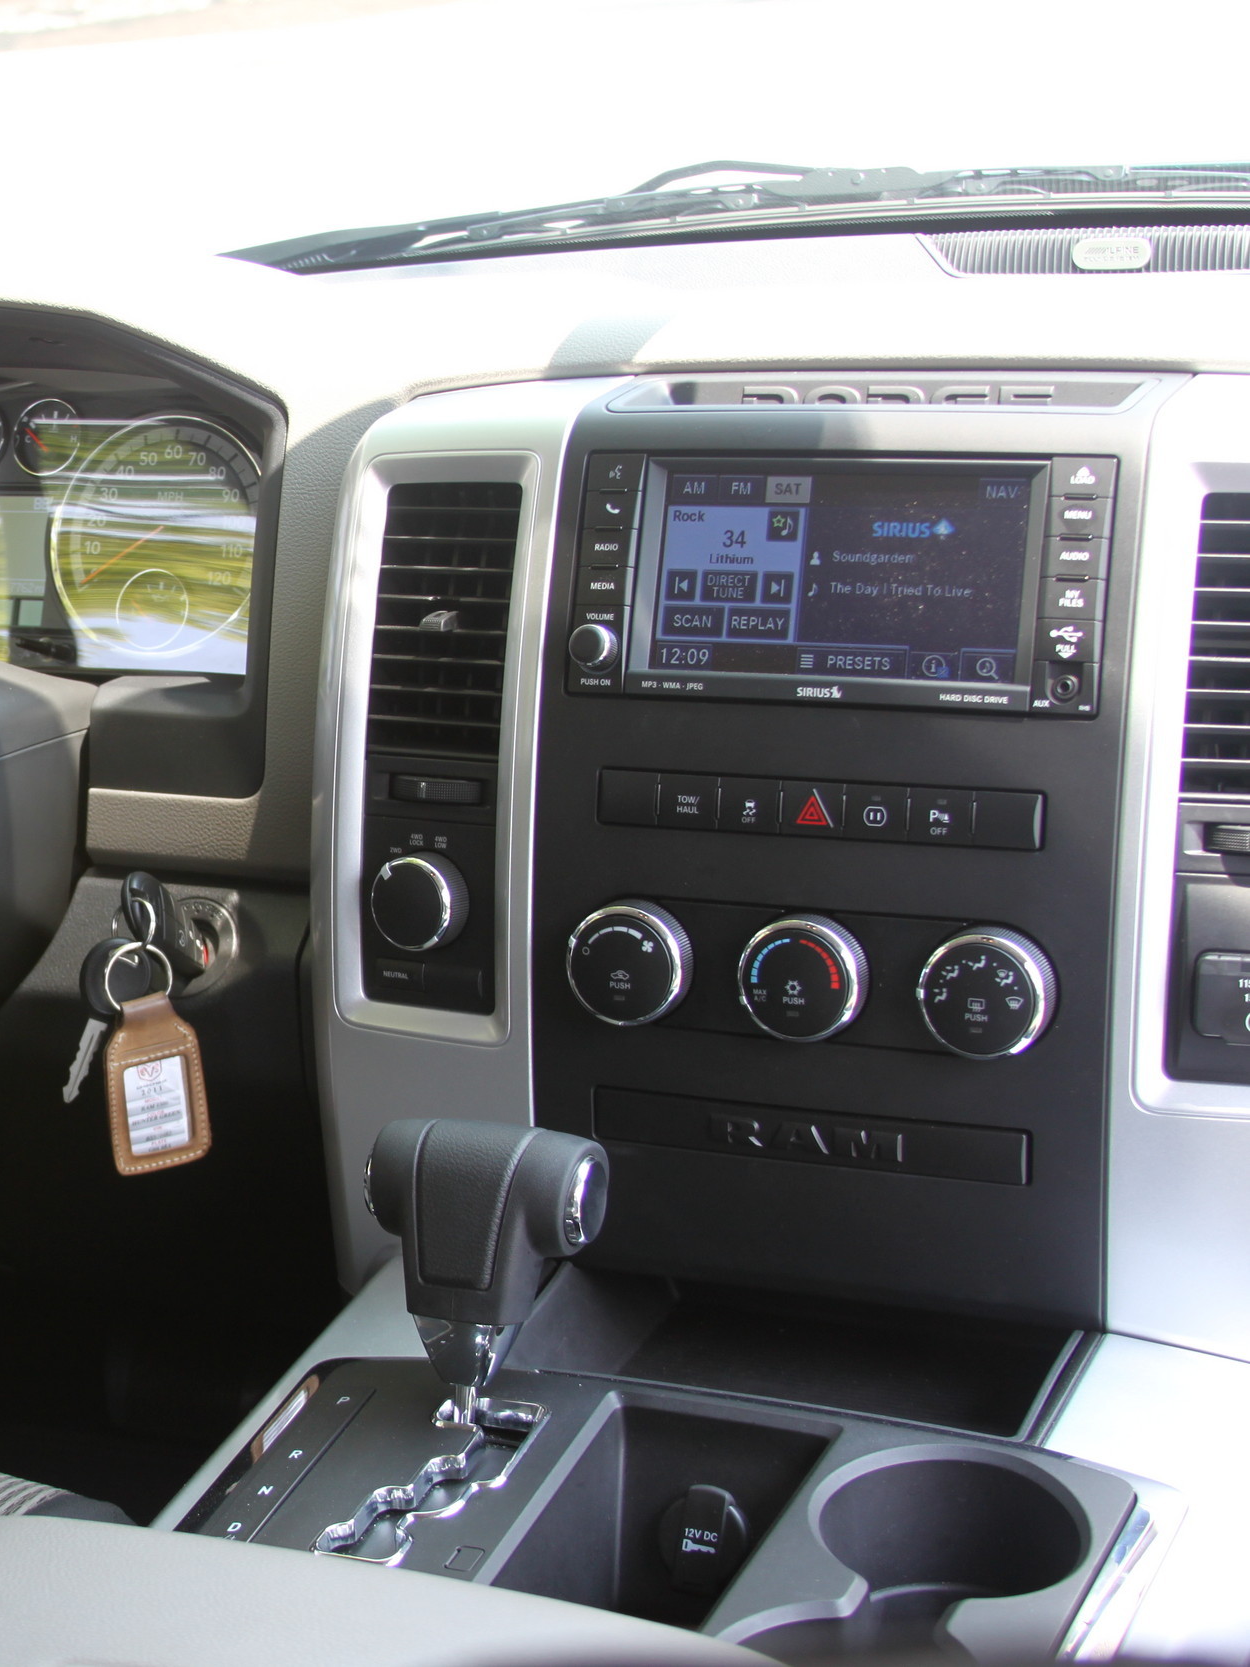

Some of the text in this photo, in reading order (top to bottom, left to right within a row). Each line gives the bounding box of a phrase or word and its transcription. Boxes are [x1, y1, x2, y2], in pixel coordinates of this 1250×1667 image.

[165, 445, 182, 459] 60
[139, 452, 157, 466] 50
[188, 452, 206, 466] 70
[116, 466, 135, 479] 40
[208, 466, 226, 480] 80
[1070, 475, 1096, 484] LOAD
[683, 482, 705, 494] AM
[731, 482, 751, 495] FM
[774, 483, 802, 495] SAT
[986, 485, 1019, 499] NAV
[100, 488, 118, 501] 30
[222, 488, 240, 502] 90
[673, 510, 706, 522] Rock
[1064, 510, 1092, 520] MENU
[872, 521, 932, 538] SIRIUS
[722, 530, 747, 549] 34
[84, 541, 101, 555] 10
[220, 545, 243, 558] 110
[594, 543, 619, 551] RADIO
[709, 553, 754, 565] Lithium
[832, 551, 916, 566] Soundgarden
[1059, 551, 1090, 561] AUDIO
[207, 572, 232, 585] 120
[707, 574, 751, 587] DIRECT
[590, 582, 615, 590] MEDIA
[830, 582, 852, 594] The
[856, 582, 879, 597] Day
[890, 584, 922, 596] Tried
[926, 584, 940, 597] To
[945, 585, 973, 598] Live
[712, 587, 745, 599] TUNE
[1065, 589, 1081, 598] MY
[1059, 598, 1084, 608] FILES
[586, 612, 614, 621] VOLUME
[673, 614, 712, 628] SCAN
[731, 616, 785, 630] REPLAY
[1055, 644, 1077, 653] PULL
[660, 648, 709, 665] 12:09
[827, 655, 891, 671] PRESETS
[580, 678, 611, 686] PUSH ON
[641, 680, 704, 691] MP3 WMA JPEG
[796, 686, 831, 698] SIRIUS
[939, 693, 1009, 705] HARD DISC DRIVE
[1033, 700, 1050, 708] AUX
[677, 795, 700, 805] TOW/
[676, 805, 699, 814] HAUL
[741, 816, 756, 824] OFF
[930, 827, 948, 836] OFF
[390, 846, 402, 854] 2WD
[383, 970, 409, 980] NEUTRAL
[609, 981, 631, 990] PUSH
[753, 988, 767, 996] MAX
[782, 996, 805, 1006] PUSH
[965, 1013, 988, 1022] PUSH
[710, 1114, 904, 1162] RAM
[336, 1396, 350, 1405] P
[288, 1450, 303, 1458] R
[257, 1486, 274, 1495] N
[227, 1522, 242, 1532] D
[684, 1528, 718, 1542] 12V DC
